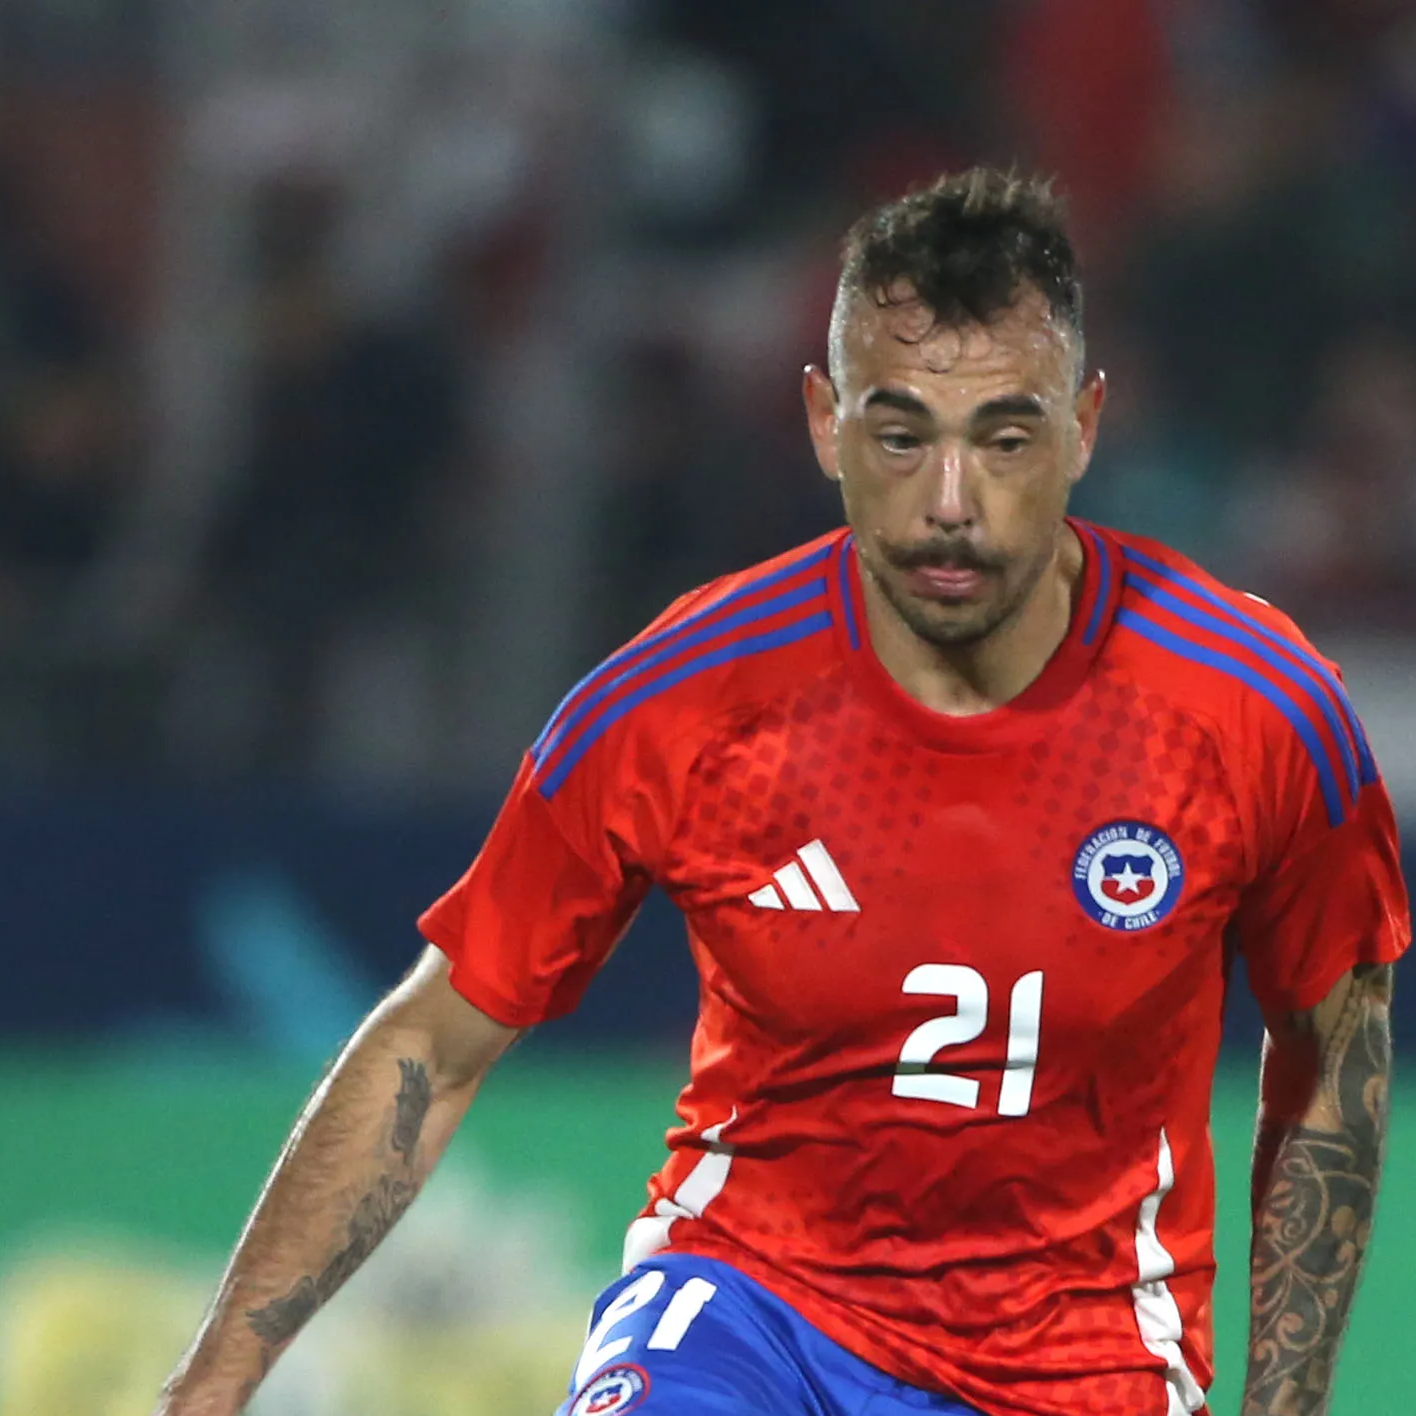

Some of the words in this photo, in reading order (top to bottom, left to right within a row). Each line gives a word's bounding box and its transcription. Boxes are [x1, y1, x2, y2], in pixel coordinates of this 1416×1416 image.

[1101, 911, 1120, 929] DE
[1124, 909, 1158, 930] CHILE
[891, 962, 1045, 1117] 21
[574, 1269, 718, 1393] 21
